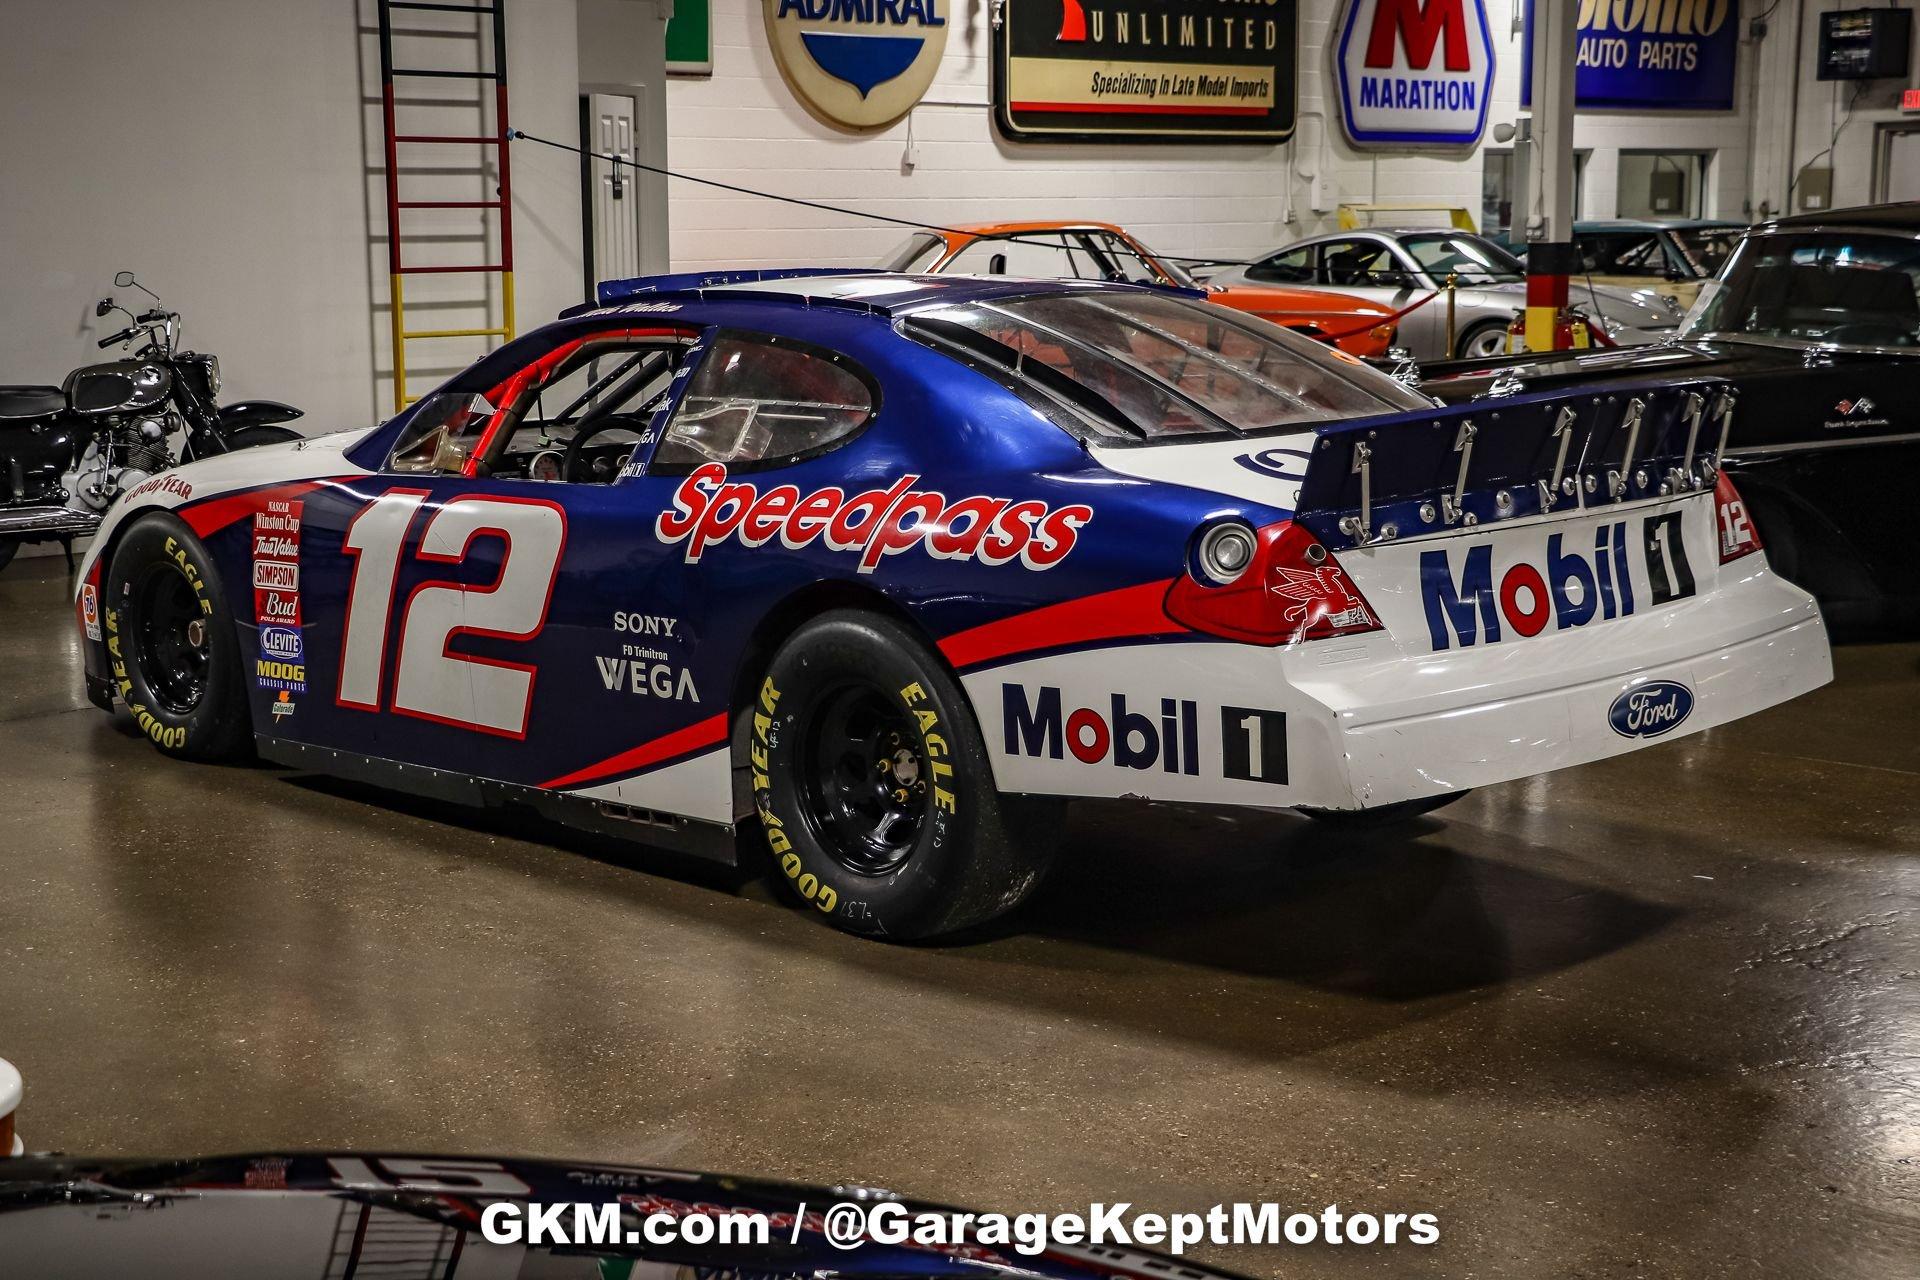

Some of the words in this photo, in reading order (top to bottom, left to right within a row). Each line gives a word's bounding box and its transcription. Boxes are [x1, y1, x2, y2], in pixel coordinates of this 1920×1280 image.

[778, 0, 946, 26] ADMIRAL
[1091, 10, 1277, 50] UNLIMITED
[1363, 0, 1470, 72] M
[1576, 37, 1629, 69] AUTO
[1638, 41, 1698, 71] PARTS
[1091, 71, 1157, 98] Specializing
[1159, 74, 1169, 94] In
[1171, 74, 1194, 96] Late
[1196, 75, 1229, 97] Model
[1230, 77, 1269, 100] Imports
[1360, 76, 1475, 111] MARATHON
[124, 473, 193, 504] GOODYEAR
[255, 512, 284, 531] Winston
[284, 514, 300, 533] Cup
[268, 501, 290, 513] NASCAR
[654, 461, 1094, 574] Speedpass
[1720, 500, 1753, 547] 12
[164, 536, 214, 616] EAGLE
[256, 564, 295, 587] SIMPSON
[1419, 521, 1635, 652] Mobil
[266, 592, 299, 616] Bud
[336, 487, 568, 741] 12
[276, 617, 296, 625] AWARD
[614, 611, 677, 637] SONY
[263, 627, 299, 652] CLEVITE
[622, 644, 633, 656] FD
[634, 645, 668, 661] Trinitron
[256, 659, 305, 682] MOOG
[286, 680, 306, 692] PARTS
[595, 656, 701, 703] WEGA
[1627, 688, 1679, 730] Ford
[1002, 682, 1201, 777] Mobil
[899, 681, 956, 815] EAGLE
